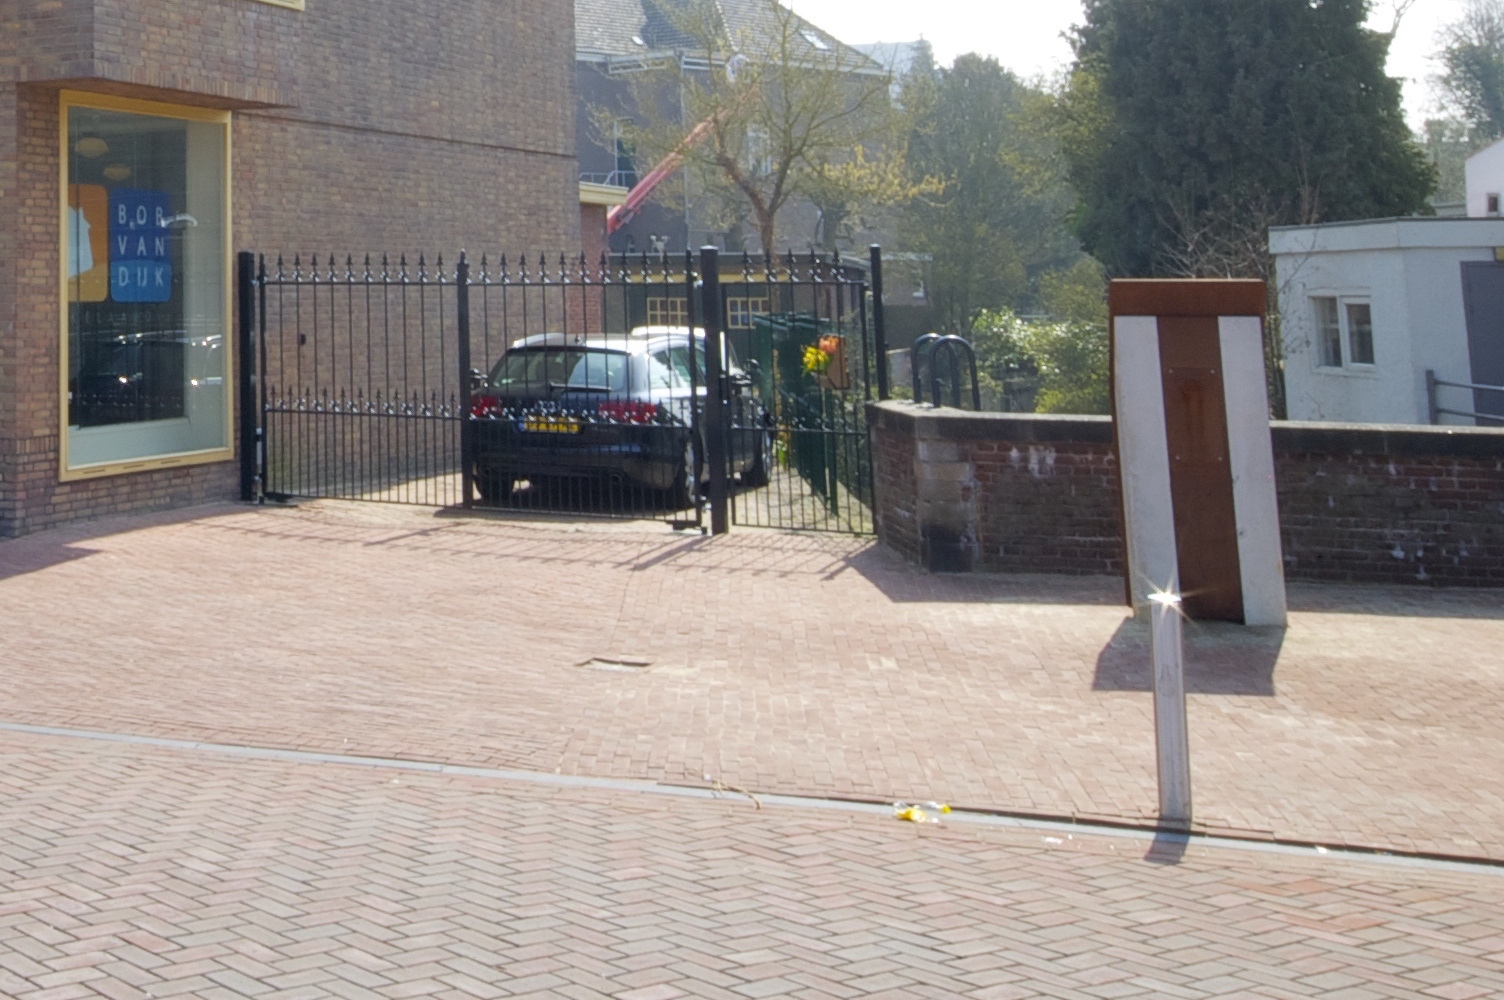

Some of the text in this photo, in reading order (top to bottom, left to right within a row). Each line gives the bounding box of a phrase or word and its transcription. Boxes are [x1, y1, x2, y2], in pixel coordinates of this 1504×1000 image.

[118, 203, 164, 227] BOB
[117, 235, 165, 256] VAN
[118, 266, 164, 287] DIJK
